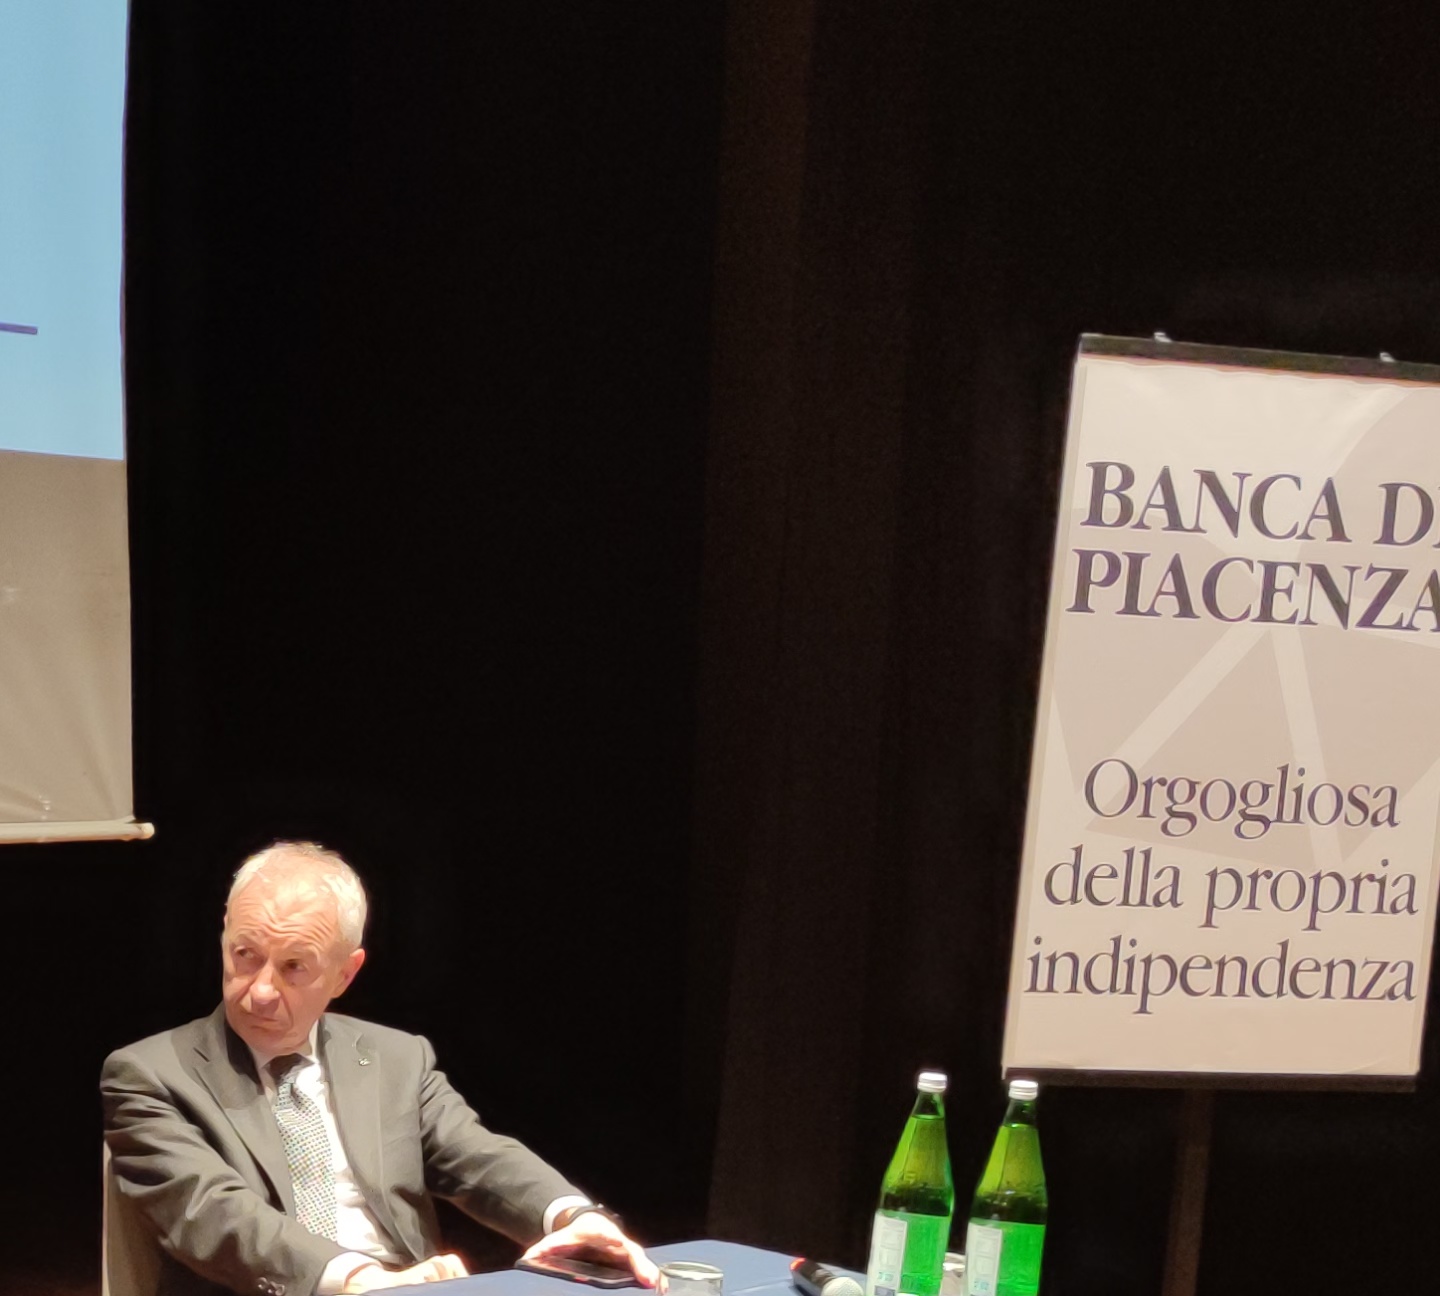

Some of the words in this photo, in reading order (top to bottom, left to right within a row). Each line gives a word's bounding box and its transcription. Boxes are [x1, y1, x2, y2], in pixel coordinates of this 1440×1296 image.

[1080, 461, 1353, 539] BANCA
[1084, 758, 1401, 839] Orgogliosa
[1044, 843, 1184, 908] della
[1198, 859, 1419, 932] propria
[1024, 934, 1418, 1015] indipendenza
